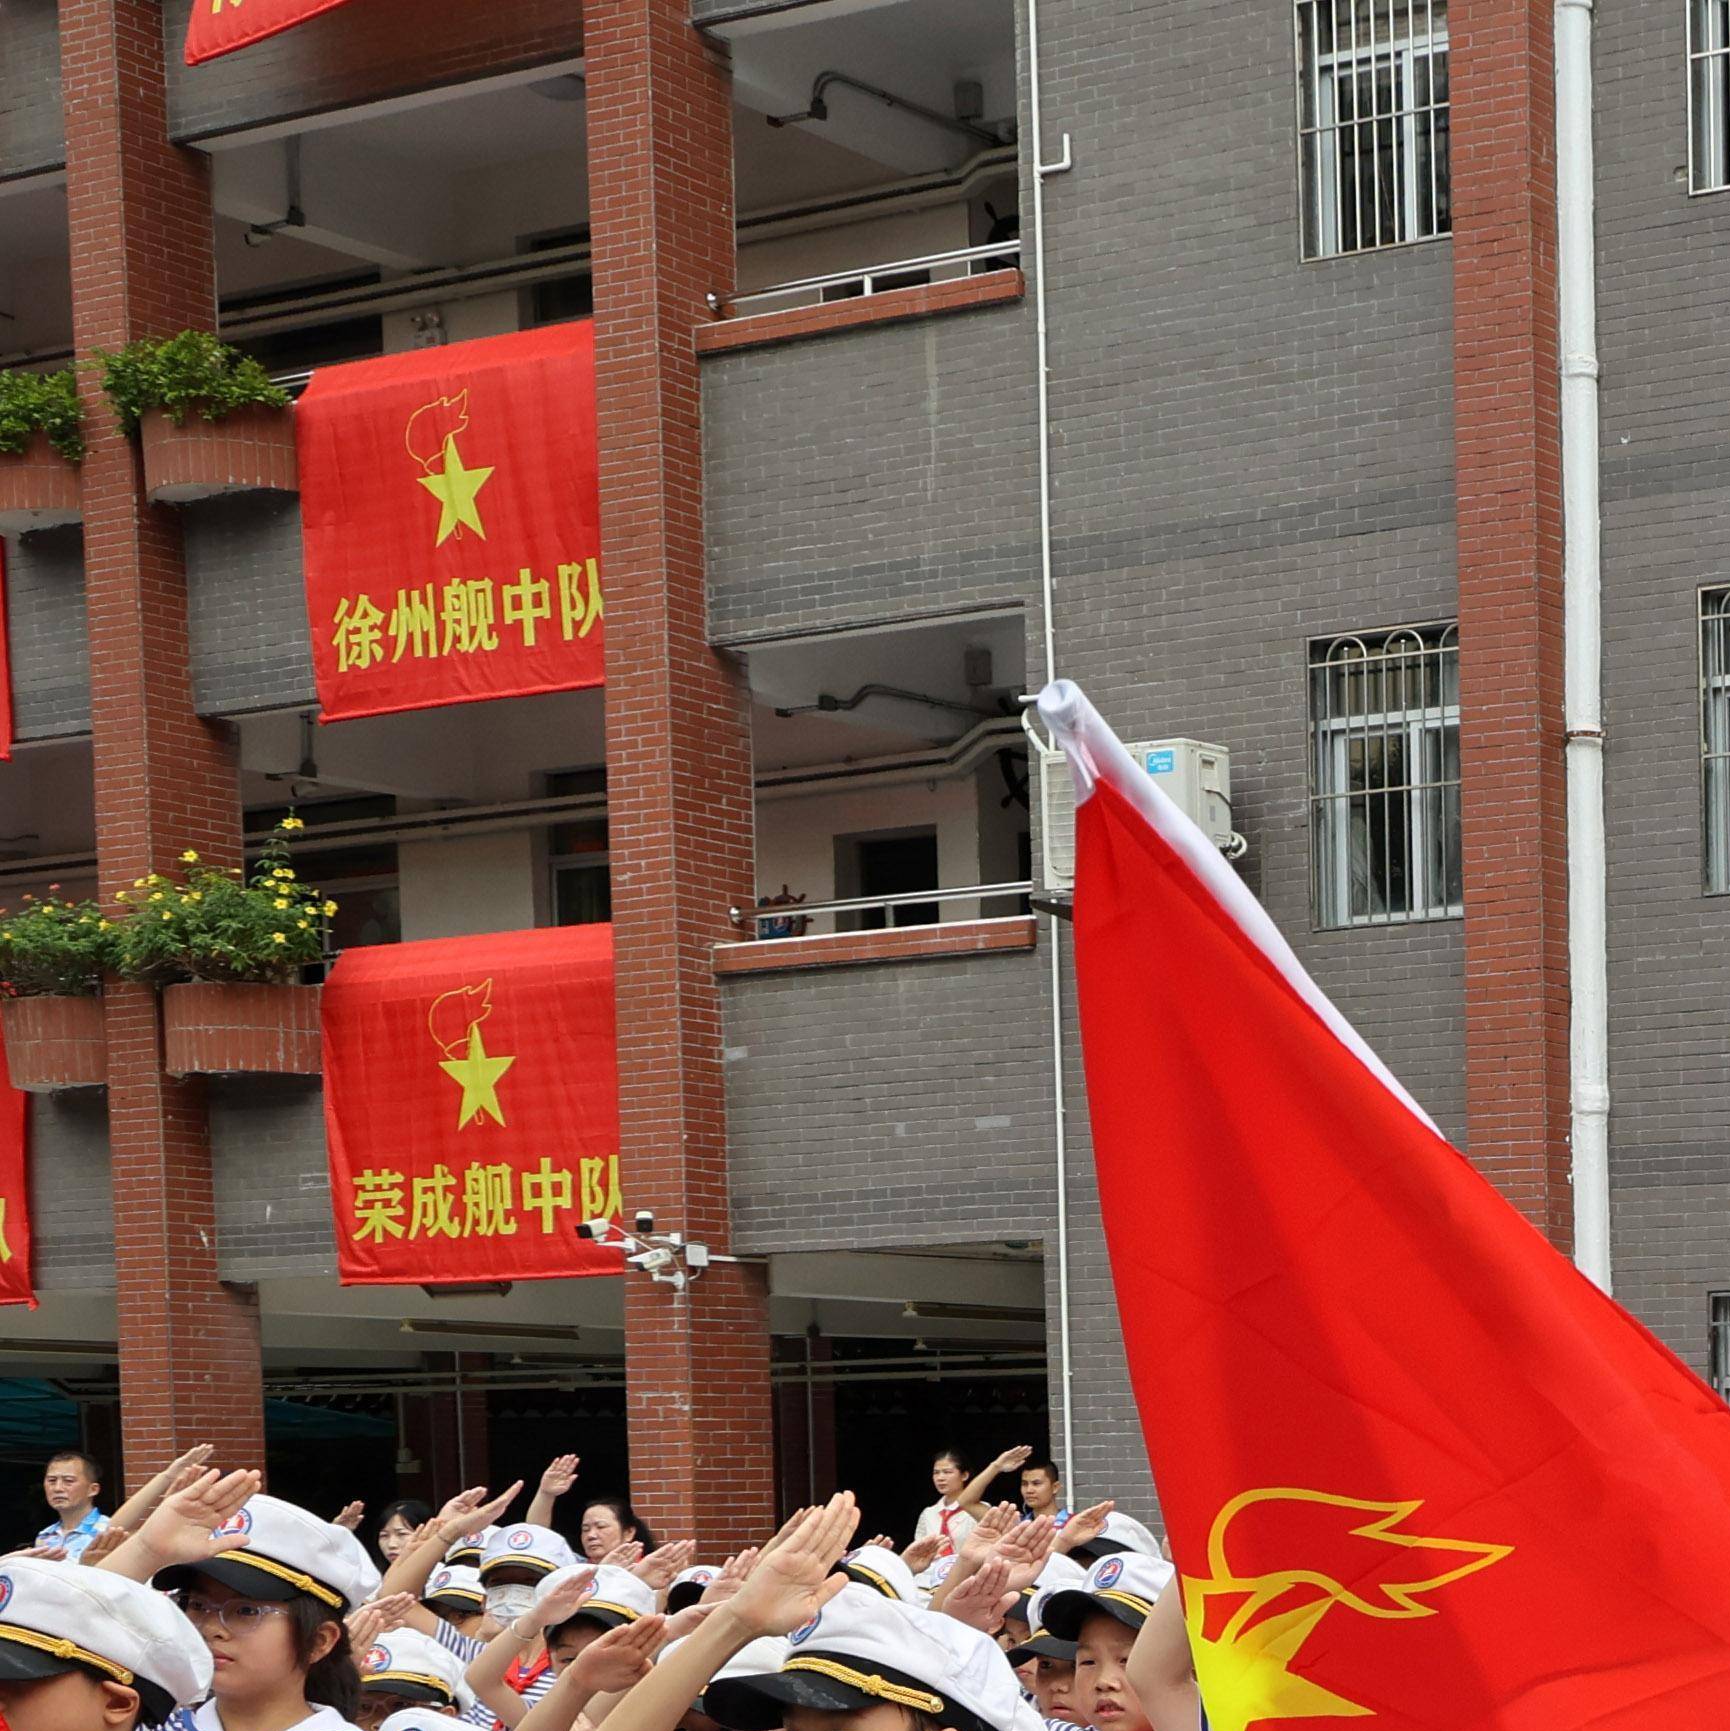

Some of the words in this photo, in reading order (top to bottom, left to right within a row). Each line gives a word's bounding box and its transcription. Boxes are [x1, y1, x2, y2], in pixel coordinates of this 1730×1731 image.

[332, 558, 604, 672] 徐州舰中队
[352, 1154, 623, 1243] 荣成舰中队
